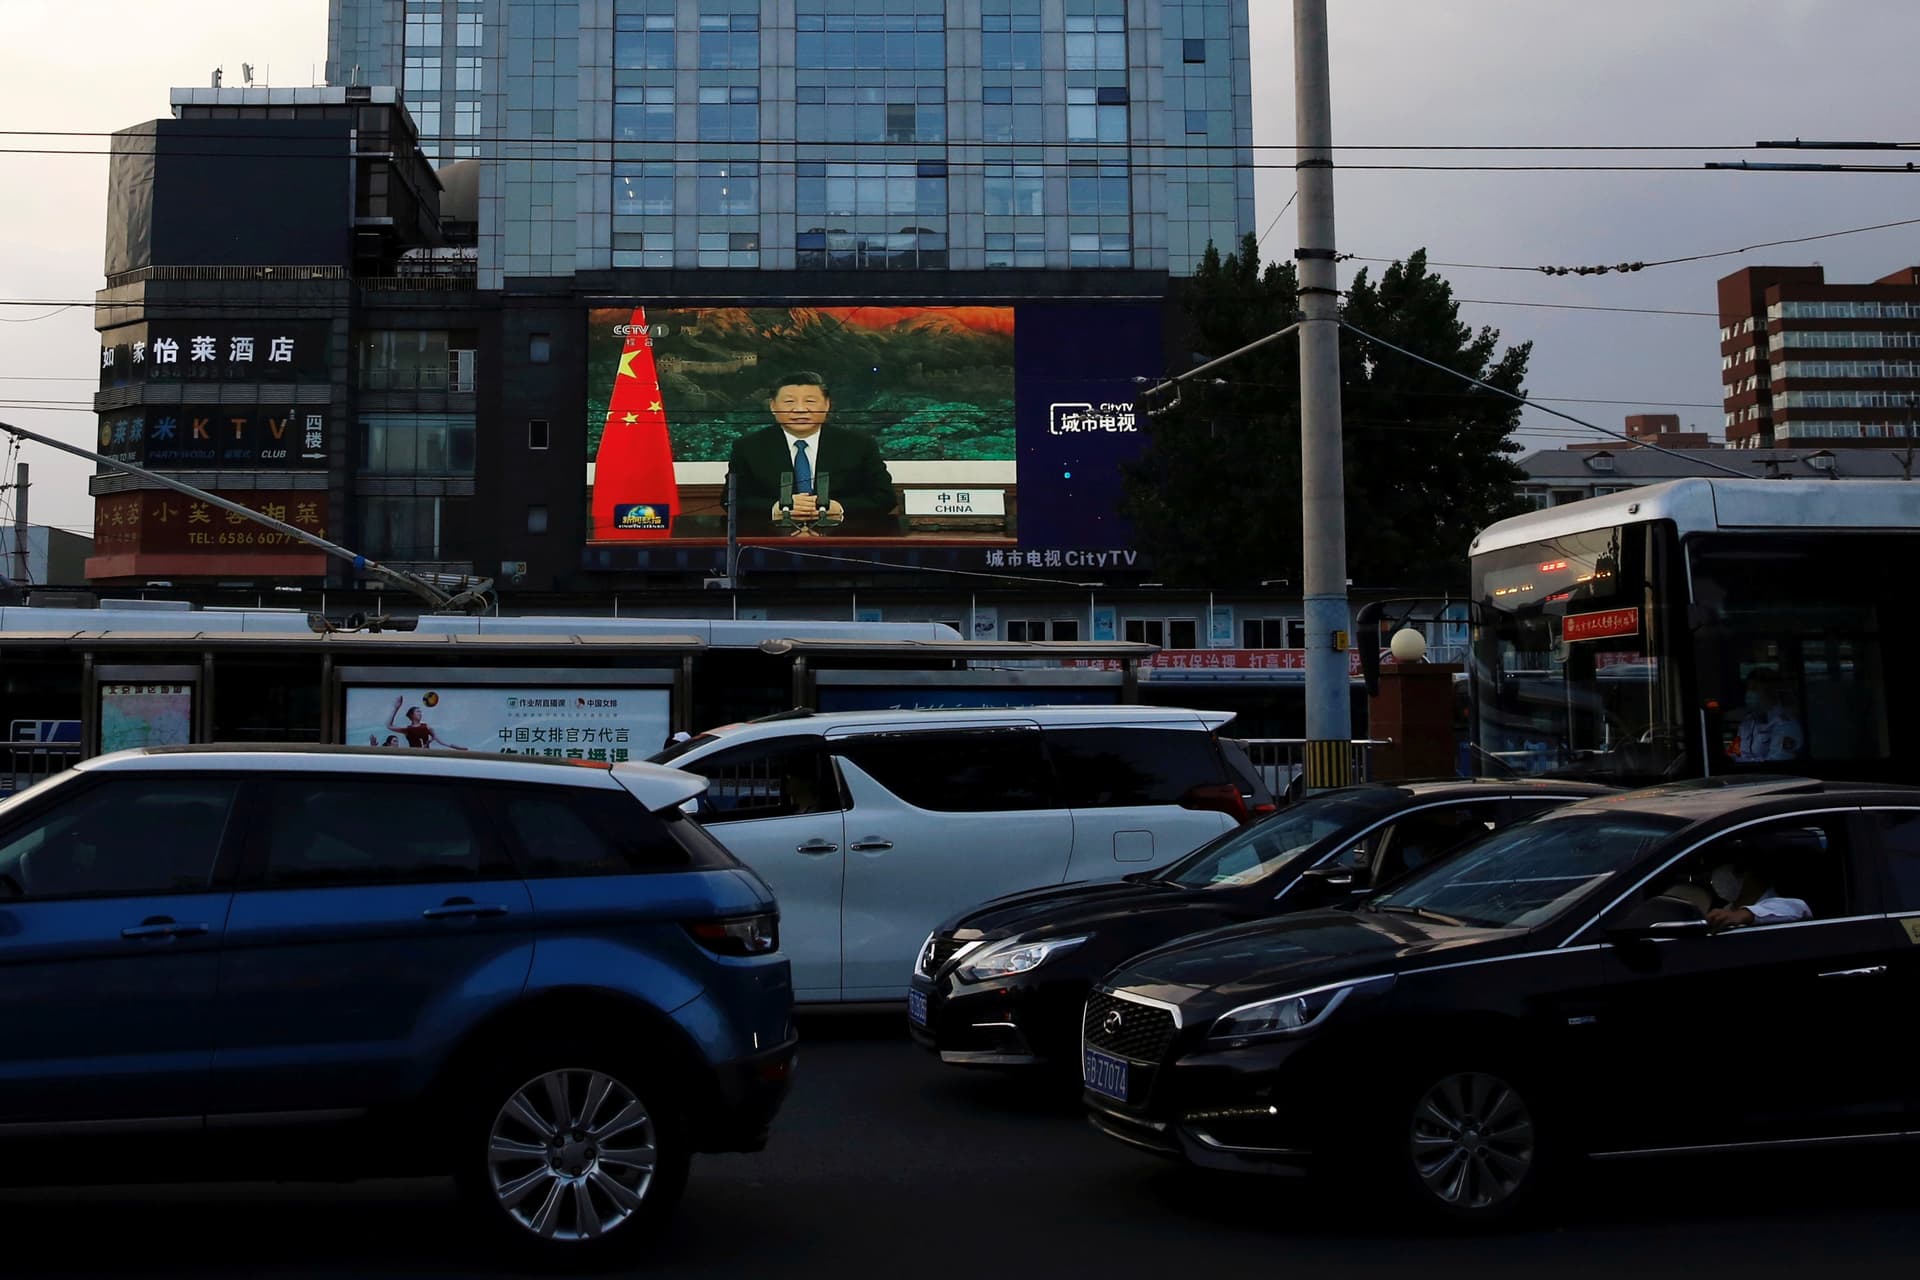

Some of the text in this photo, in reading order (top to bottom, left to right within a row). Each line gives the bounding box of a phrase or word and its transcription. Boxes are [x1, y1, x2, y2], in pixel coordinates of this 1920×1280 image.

[613, 325, 649, 335] CCTV
[102, 336, 295, 369] 如家 怡莱酒店
[1060, 412, 1138, 433] 城市电视
[304, 415, 323, 449] 四楼
[260, 450, 287, 459] CLUB
[938, 493, 970, 503] 中国
[935, 505, 973, 513] CHINA
[188, 532, 215, 544] TEL:
[218, 532, 254, 545] 6586
[256, 532, 292, 545] 6077
[587, 699, 617, 708] 中国女排
[498, 728, 630, 743] 中国女排官方代言
